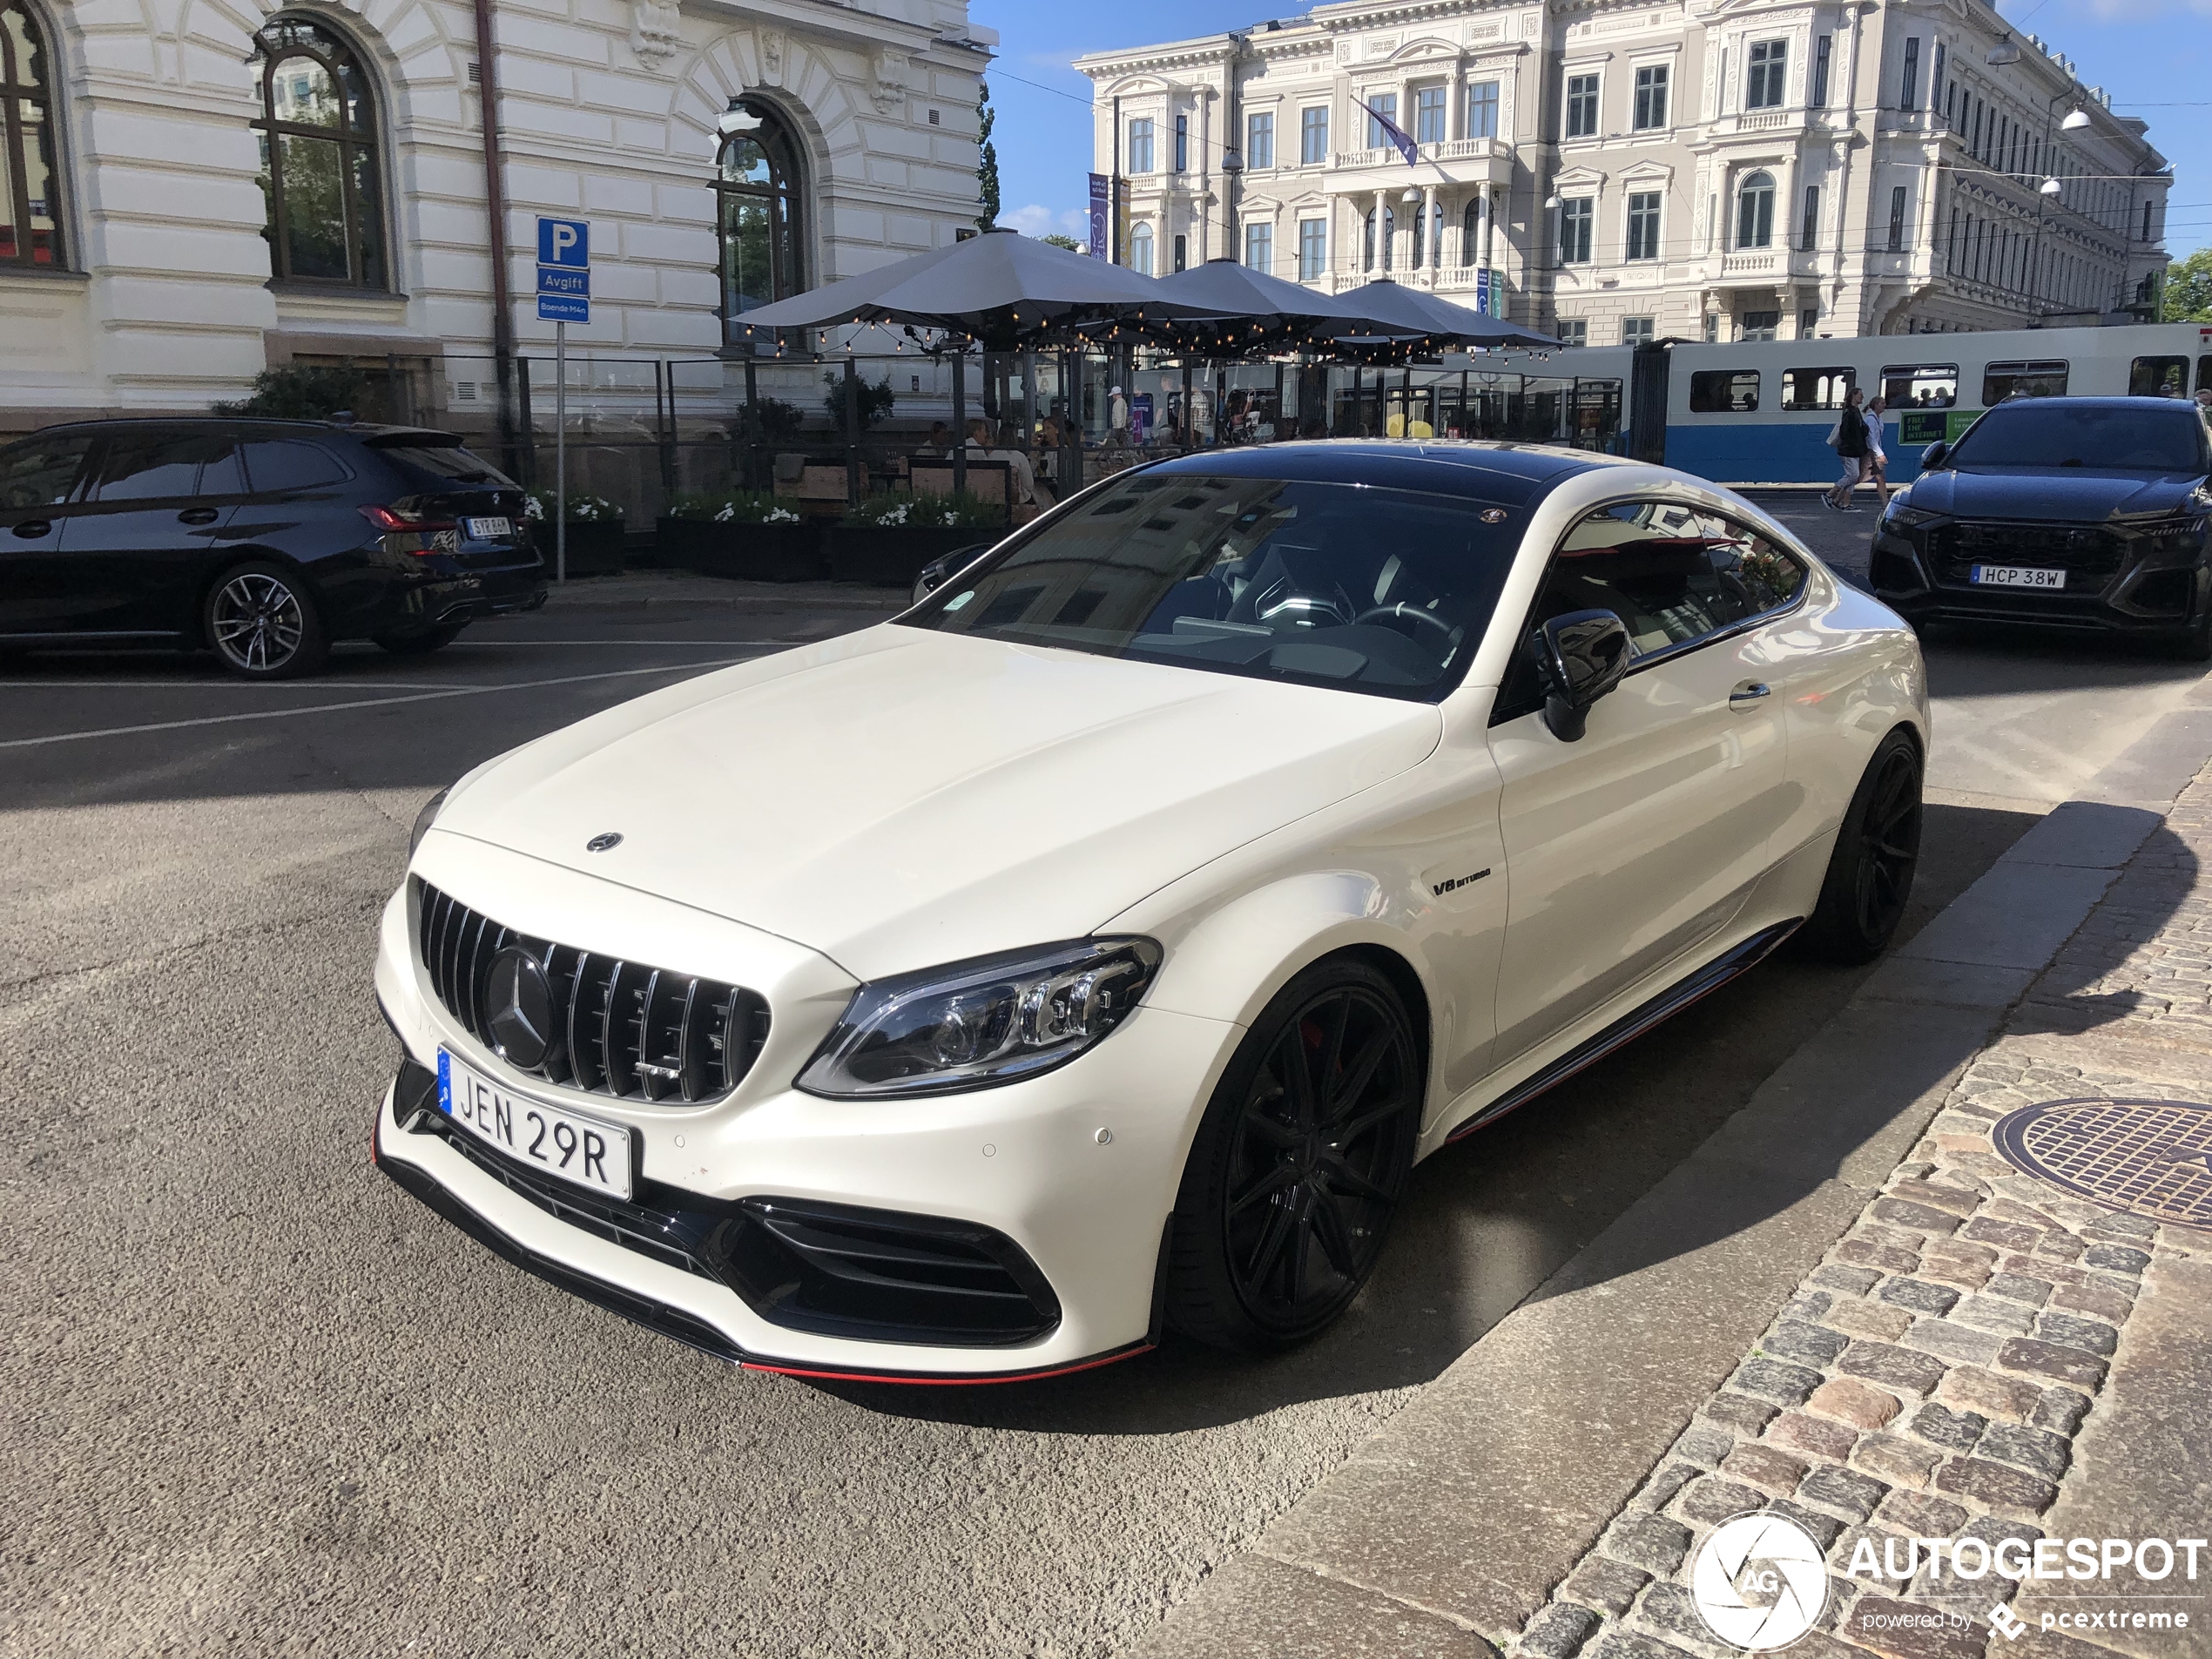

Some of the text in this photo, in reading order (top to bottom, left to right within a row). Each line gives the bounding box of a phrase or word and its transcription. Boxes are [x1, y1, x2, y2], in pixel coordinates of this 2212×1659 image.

[553, 223, 577, 261] P
[545, 275, 583, 290] Avgift
[1907, 429, 1943, 439] INTERNET
[1986, 568, 2058, 586] HCP 38W
[1433, 878, 1456, 896] V8
[460, 1074, 610, 1185] JEN 29R
